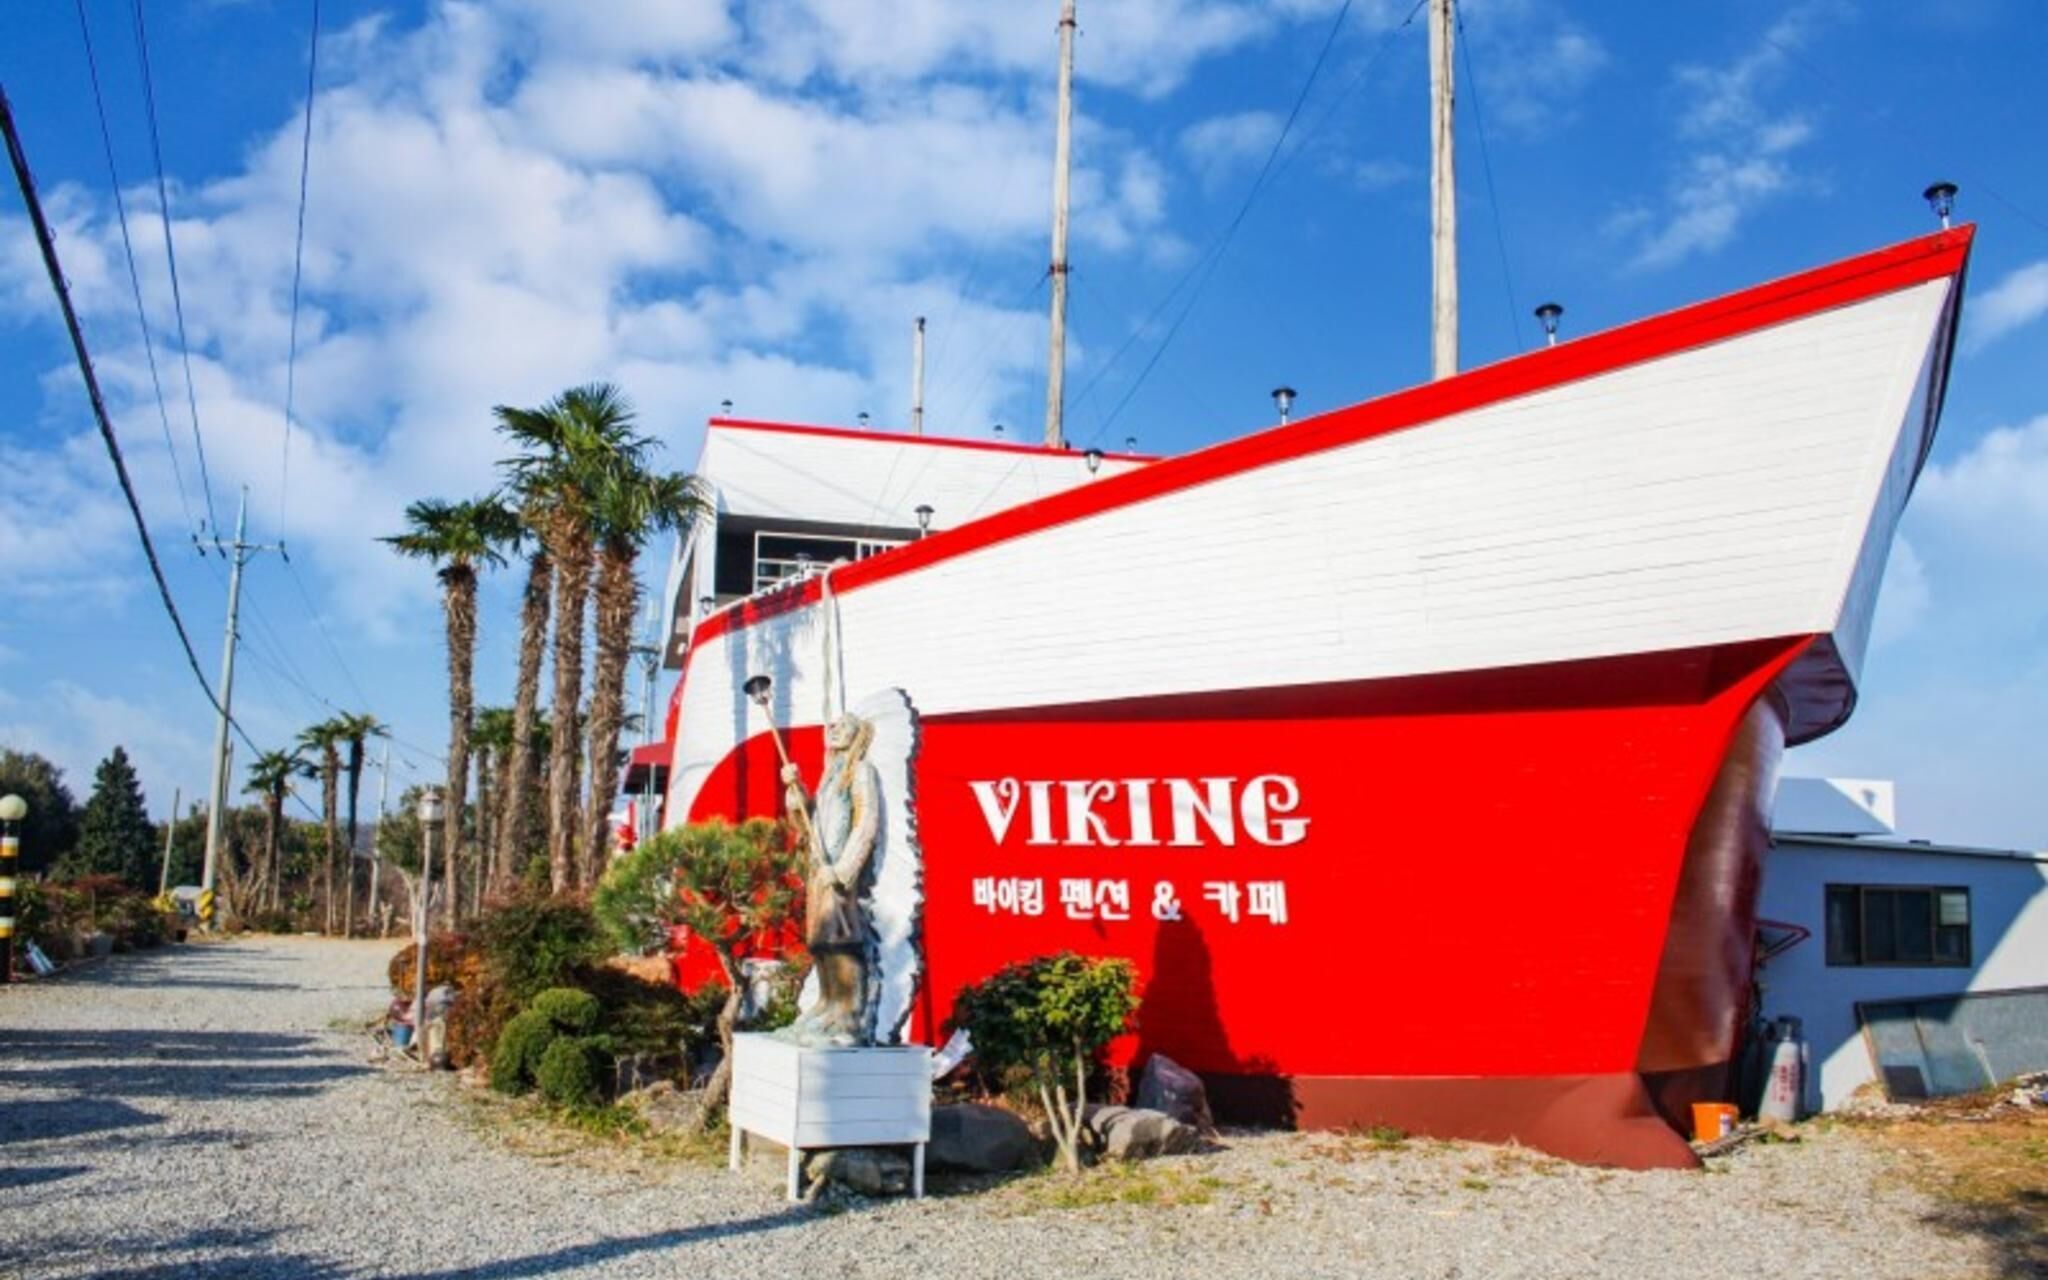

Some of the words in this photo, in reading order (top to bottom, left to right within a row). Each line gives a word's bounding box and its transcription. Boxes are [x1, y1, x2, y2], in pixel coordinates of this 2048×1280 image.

[969, 774, 1311, 847] VIKING
[972, 876, 1044, 916] 바이킹
[1059, 878, 1130, 921] 펜션
[1151, 880, 1183, 922] &
[1202, 881, 1288, 924] 카페
